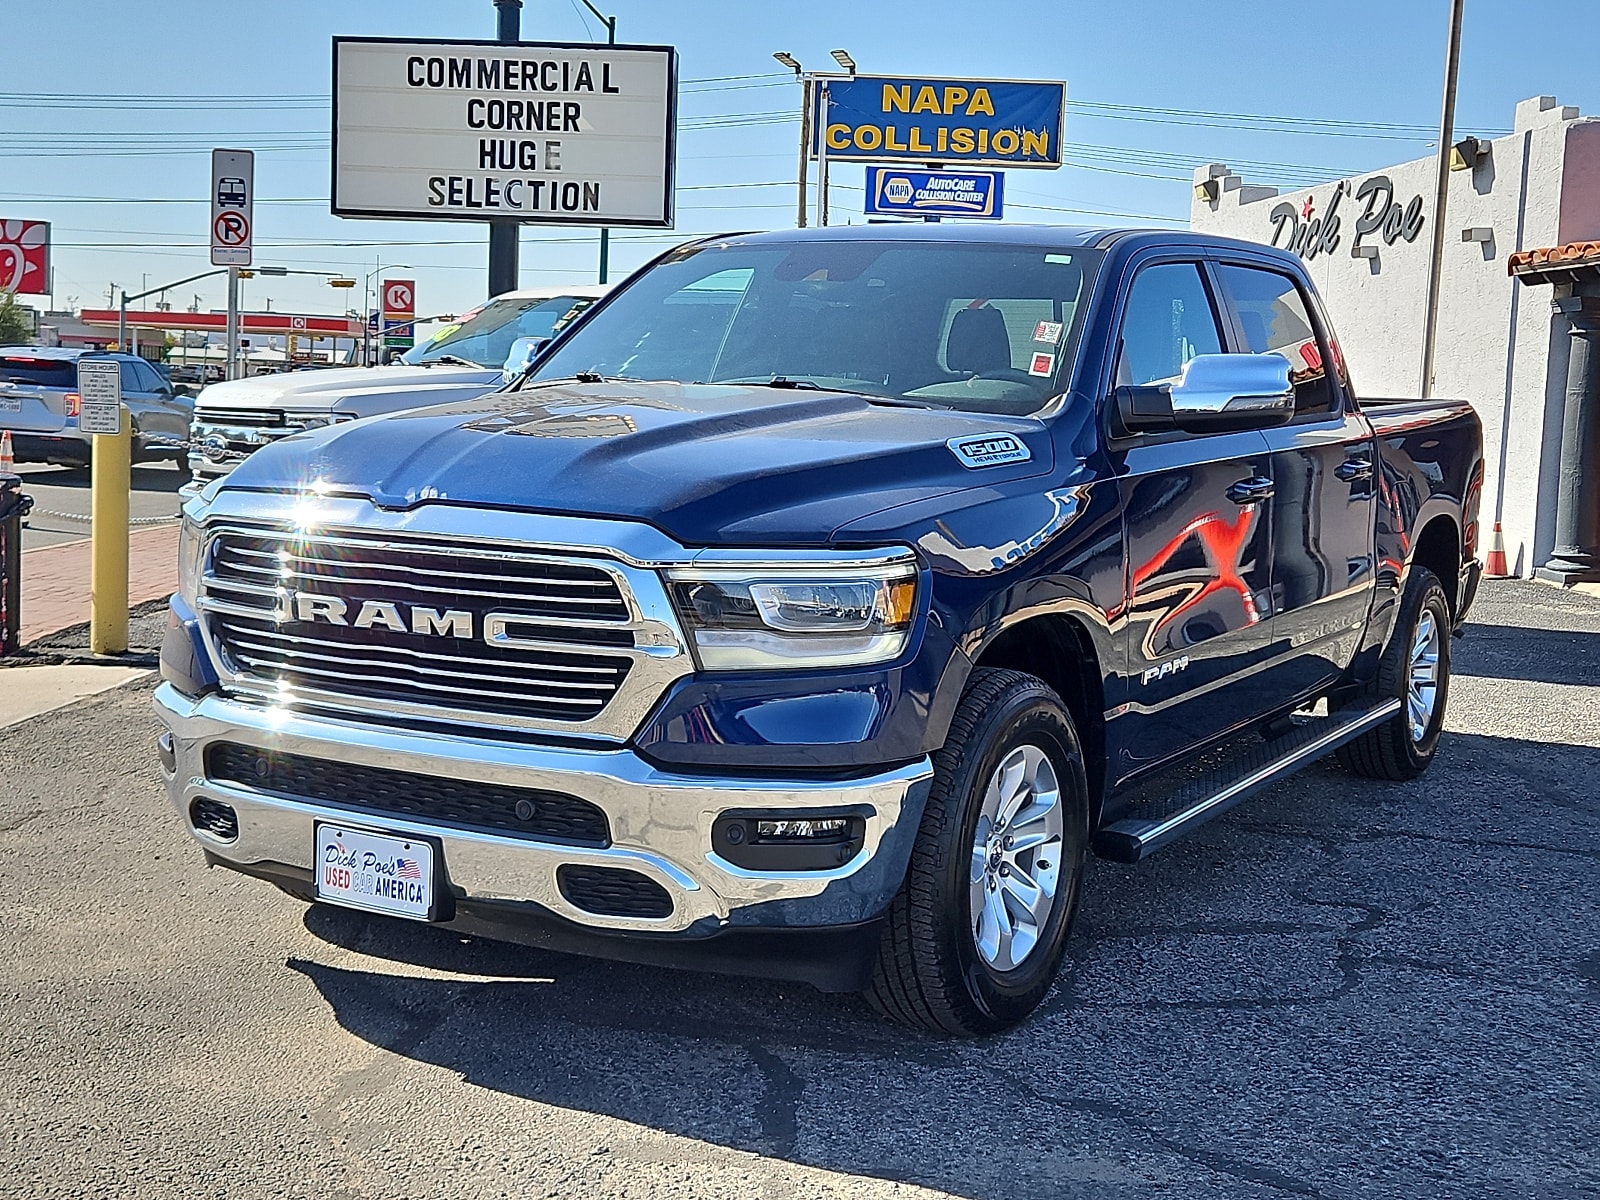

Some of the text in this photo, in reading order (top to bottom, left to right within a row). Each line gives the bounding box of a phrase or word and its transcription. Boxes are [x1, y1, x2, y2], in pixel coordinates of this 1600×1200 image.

[407, 56, 620, 94] COMMERCIAL
[467, 98, 581, 132] CORNER
[882, 84, 995, 116] NAPA
[479, 139, 561, 170] HUGE
[826, 124, 1049, 156] COLLISION
[428, 176, 600, 212] SELECTION
[889, 184, 909, 197] NAPA
[915, 189, 984, 202] COLLISION CENTER
[1270, 175, 1425, 261] Dick Poe
[961, 439, 1016, 455] 1500
[295, 591, 473, 639] RAM
[325, 844, 397, 876] Dick Poe's
[325, 866, 351, 889] USED
[375, 877, 423, 904] AMERICA
